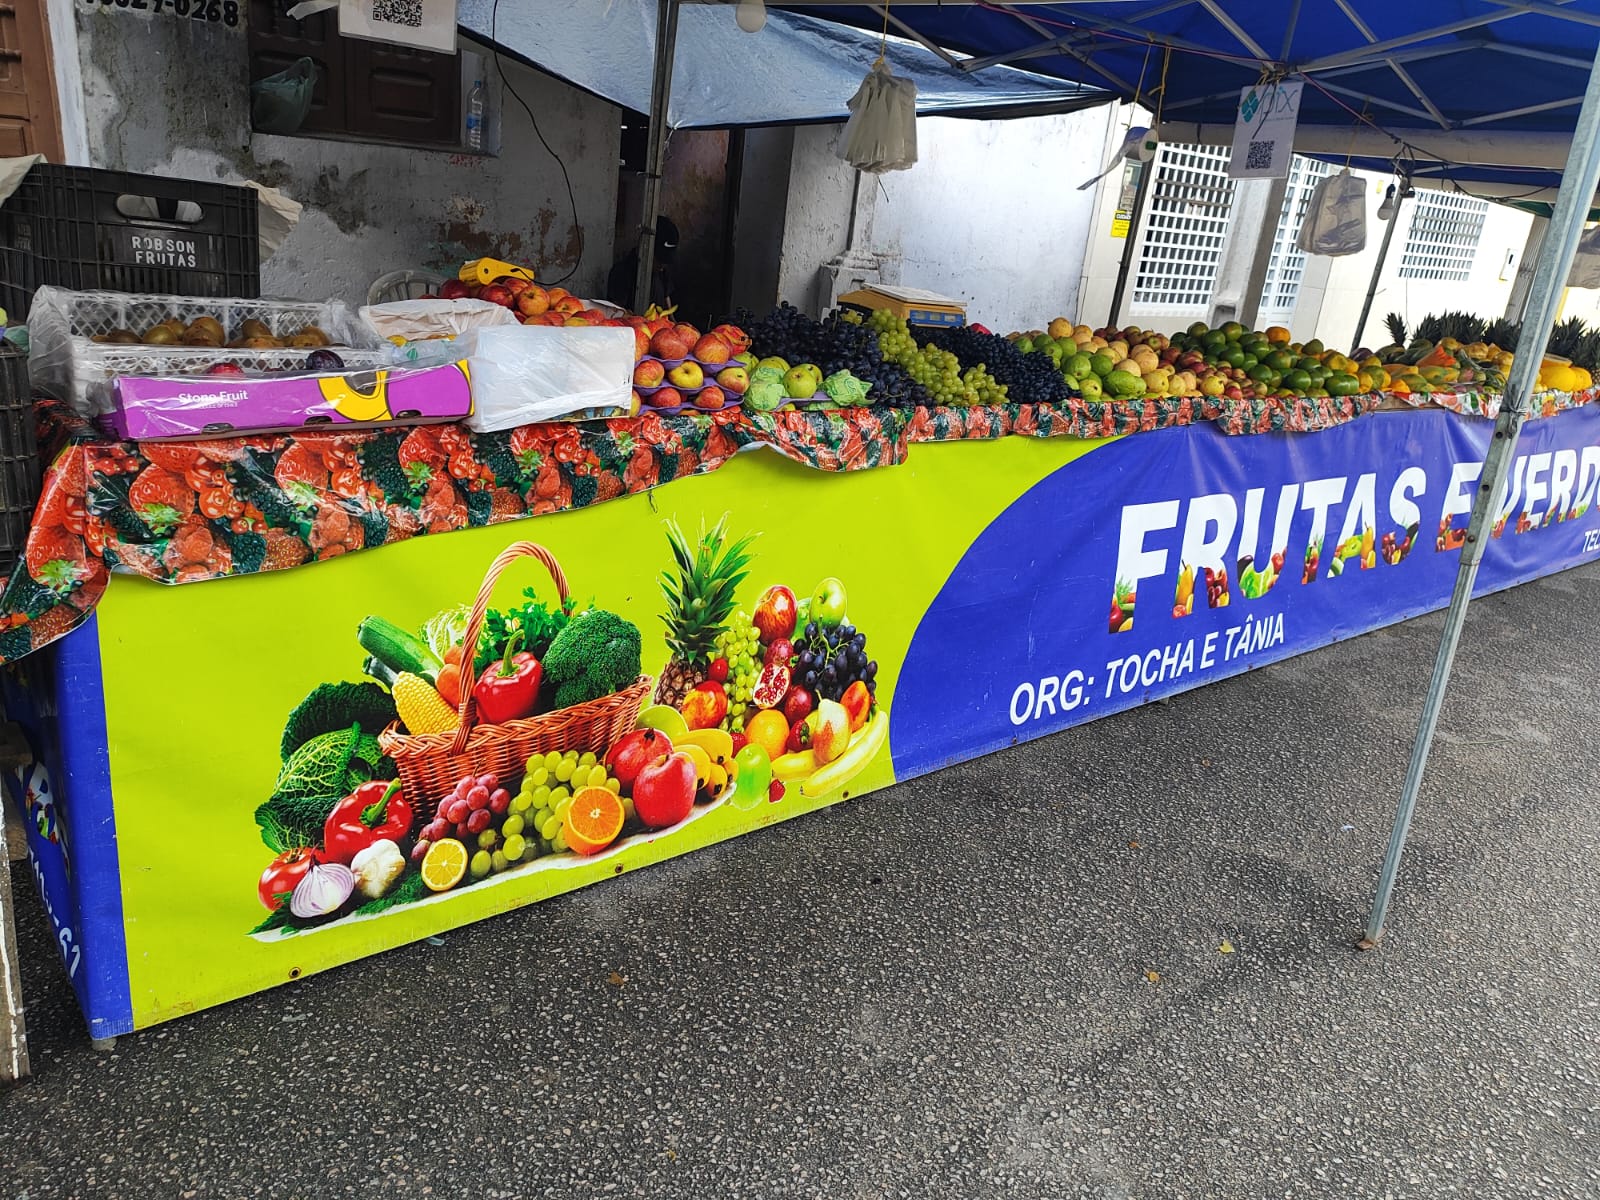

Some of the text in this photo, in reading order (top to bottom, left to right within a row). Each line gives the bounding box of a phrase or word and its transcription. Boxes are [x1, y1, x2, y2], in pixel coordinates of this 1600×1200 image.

[131, 236, 195, 254] ROBSON
[135, 251, 196, 268] FRUTAS
[178, 390, 249, 403] Stone Fruit
[1108, 445, 1600, 634] FRUTAS E VERD
[1009, 612, 1285, 726] ORG: TOCHA E TÂNIA
